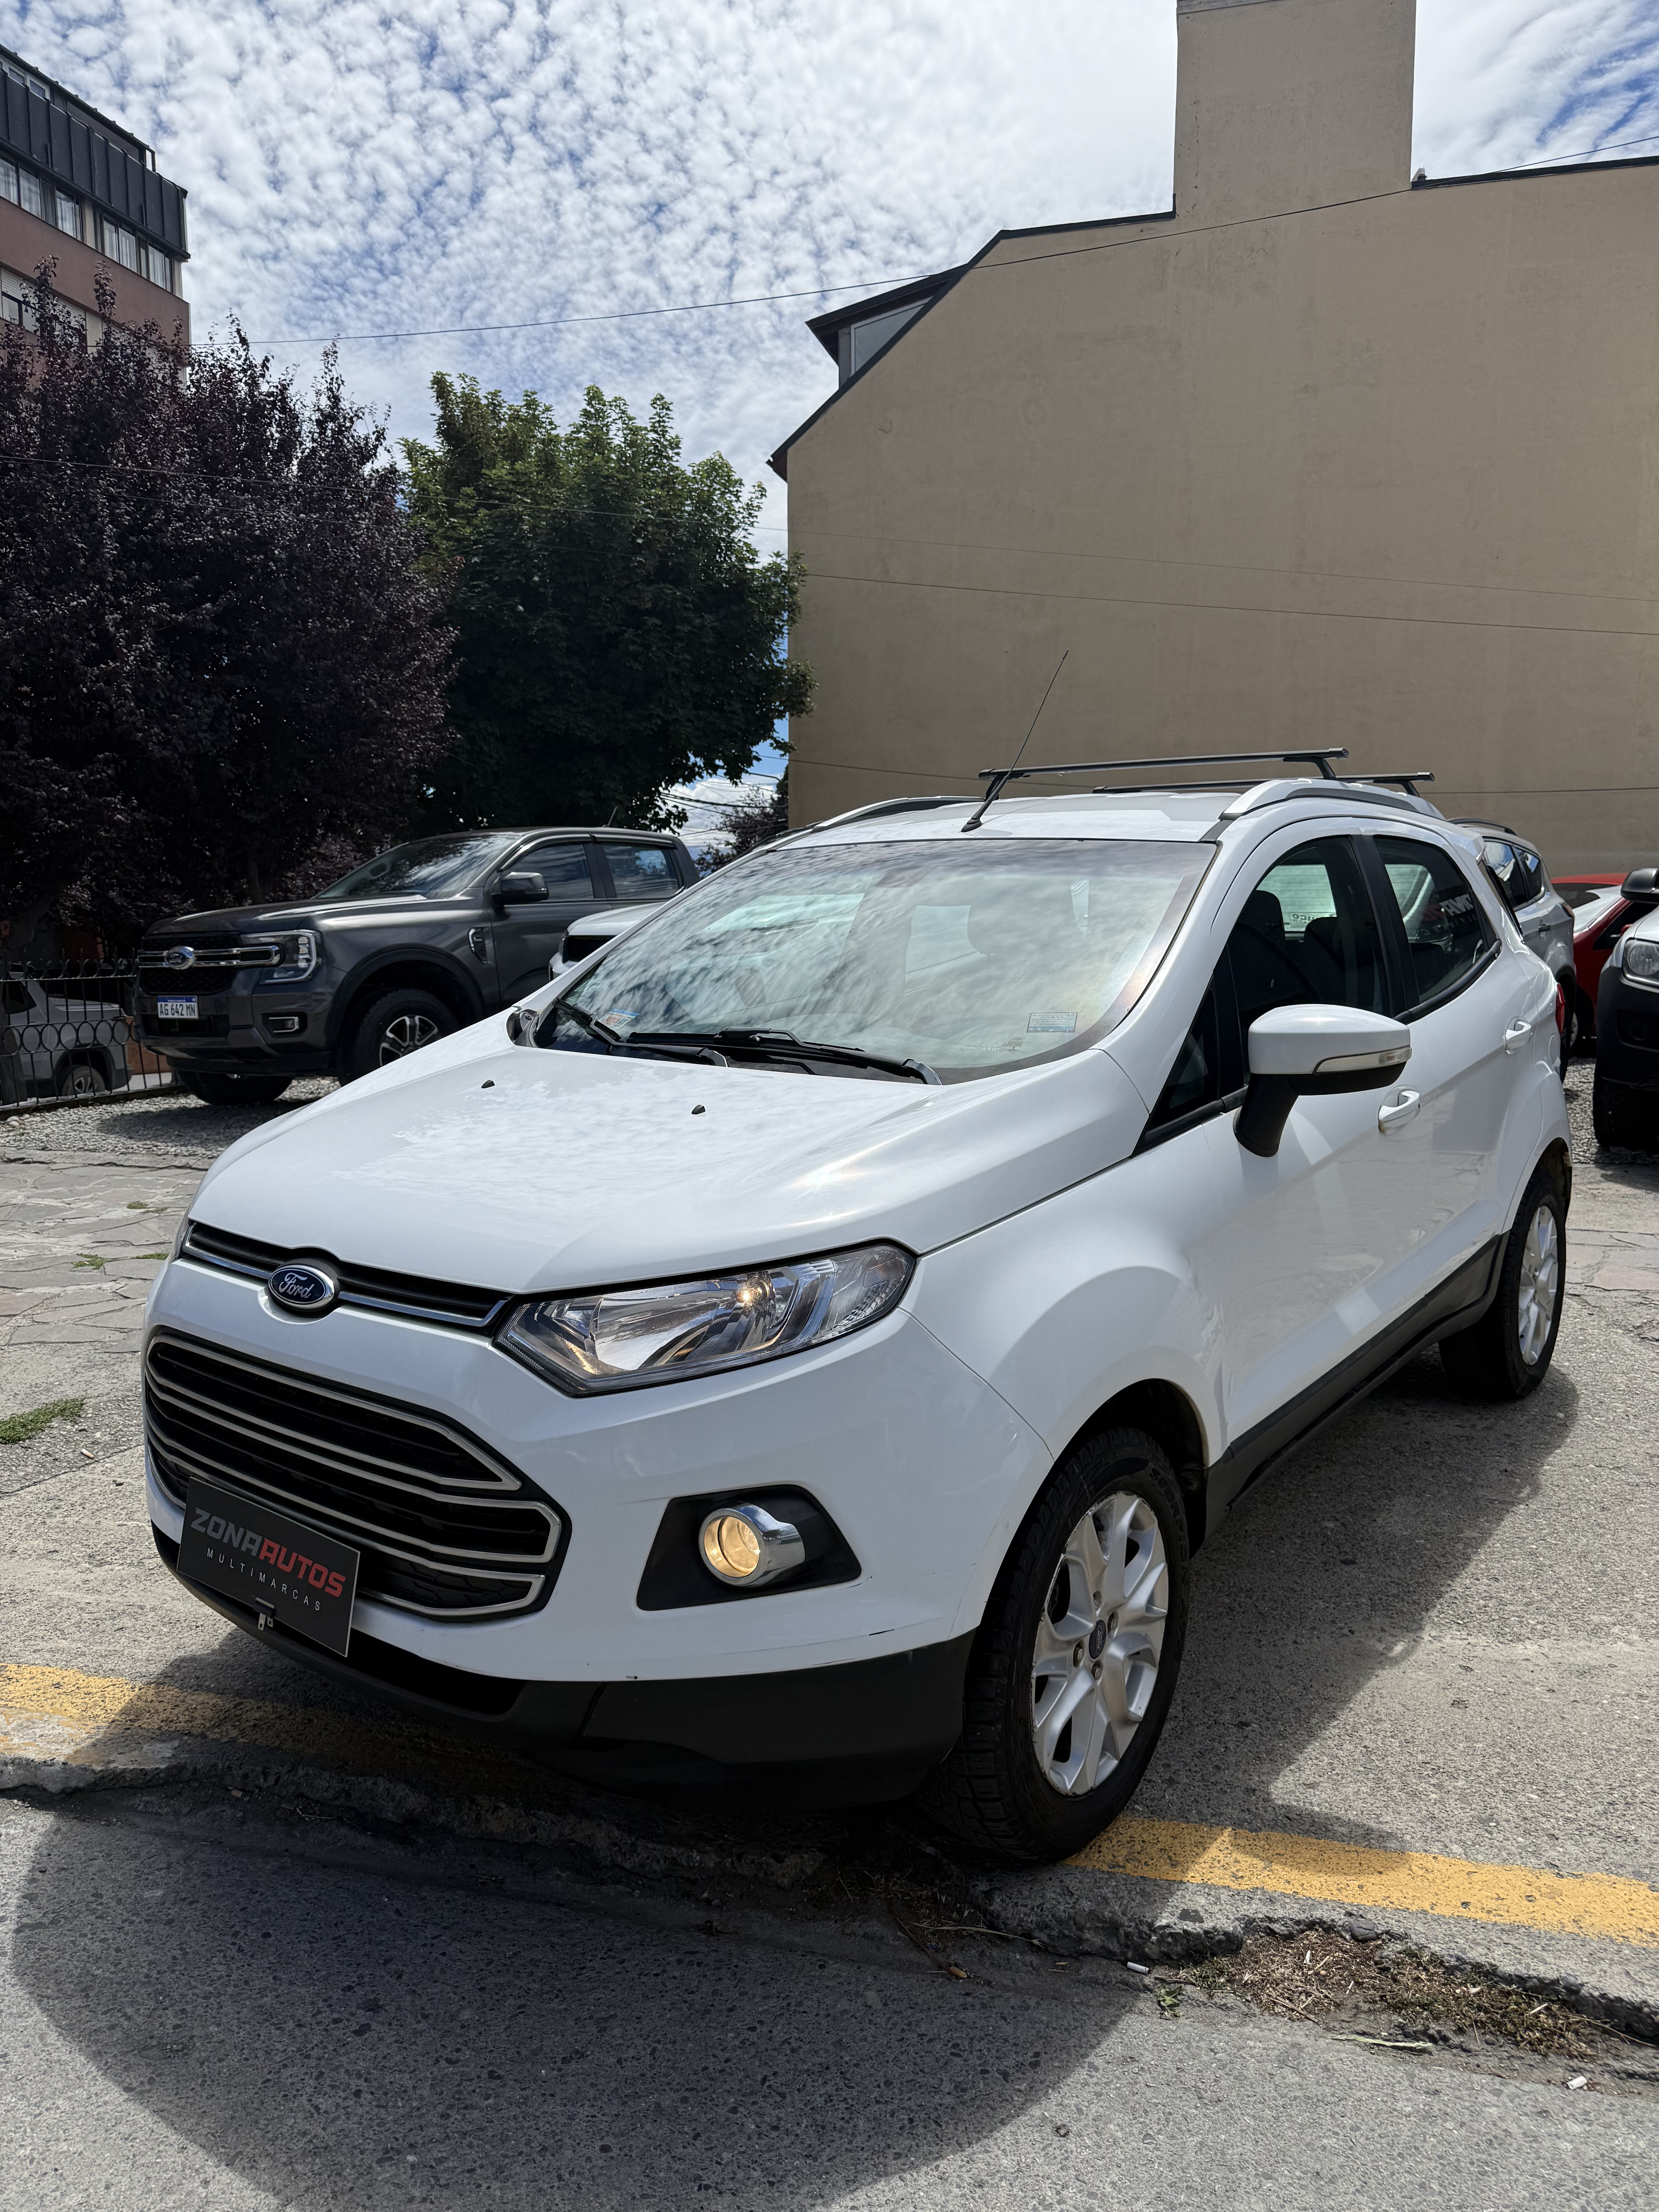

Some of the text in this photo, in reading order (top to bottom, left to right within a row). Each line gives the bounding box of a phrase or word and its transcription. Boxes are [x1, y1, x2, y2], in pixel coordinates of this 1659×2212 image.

[160, 1003, 196, 1017] AG 642 MN
[278, 1272, 315, 1298] Ford
[207, 1548, 320, 1611] MULTIMARCAS
